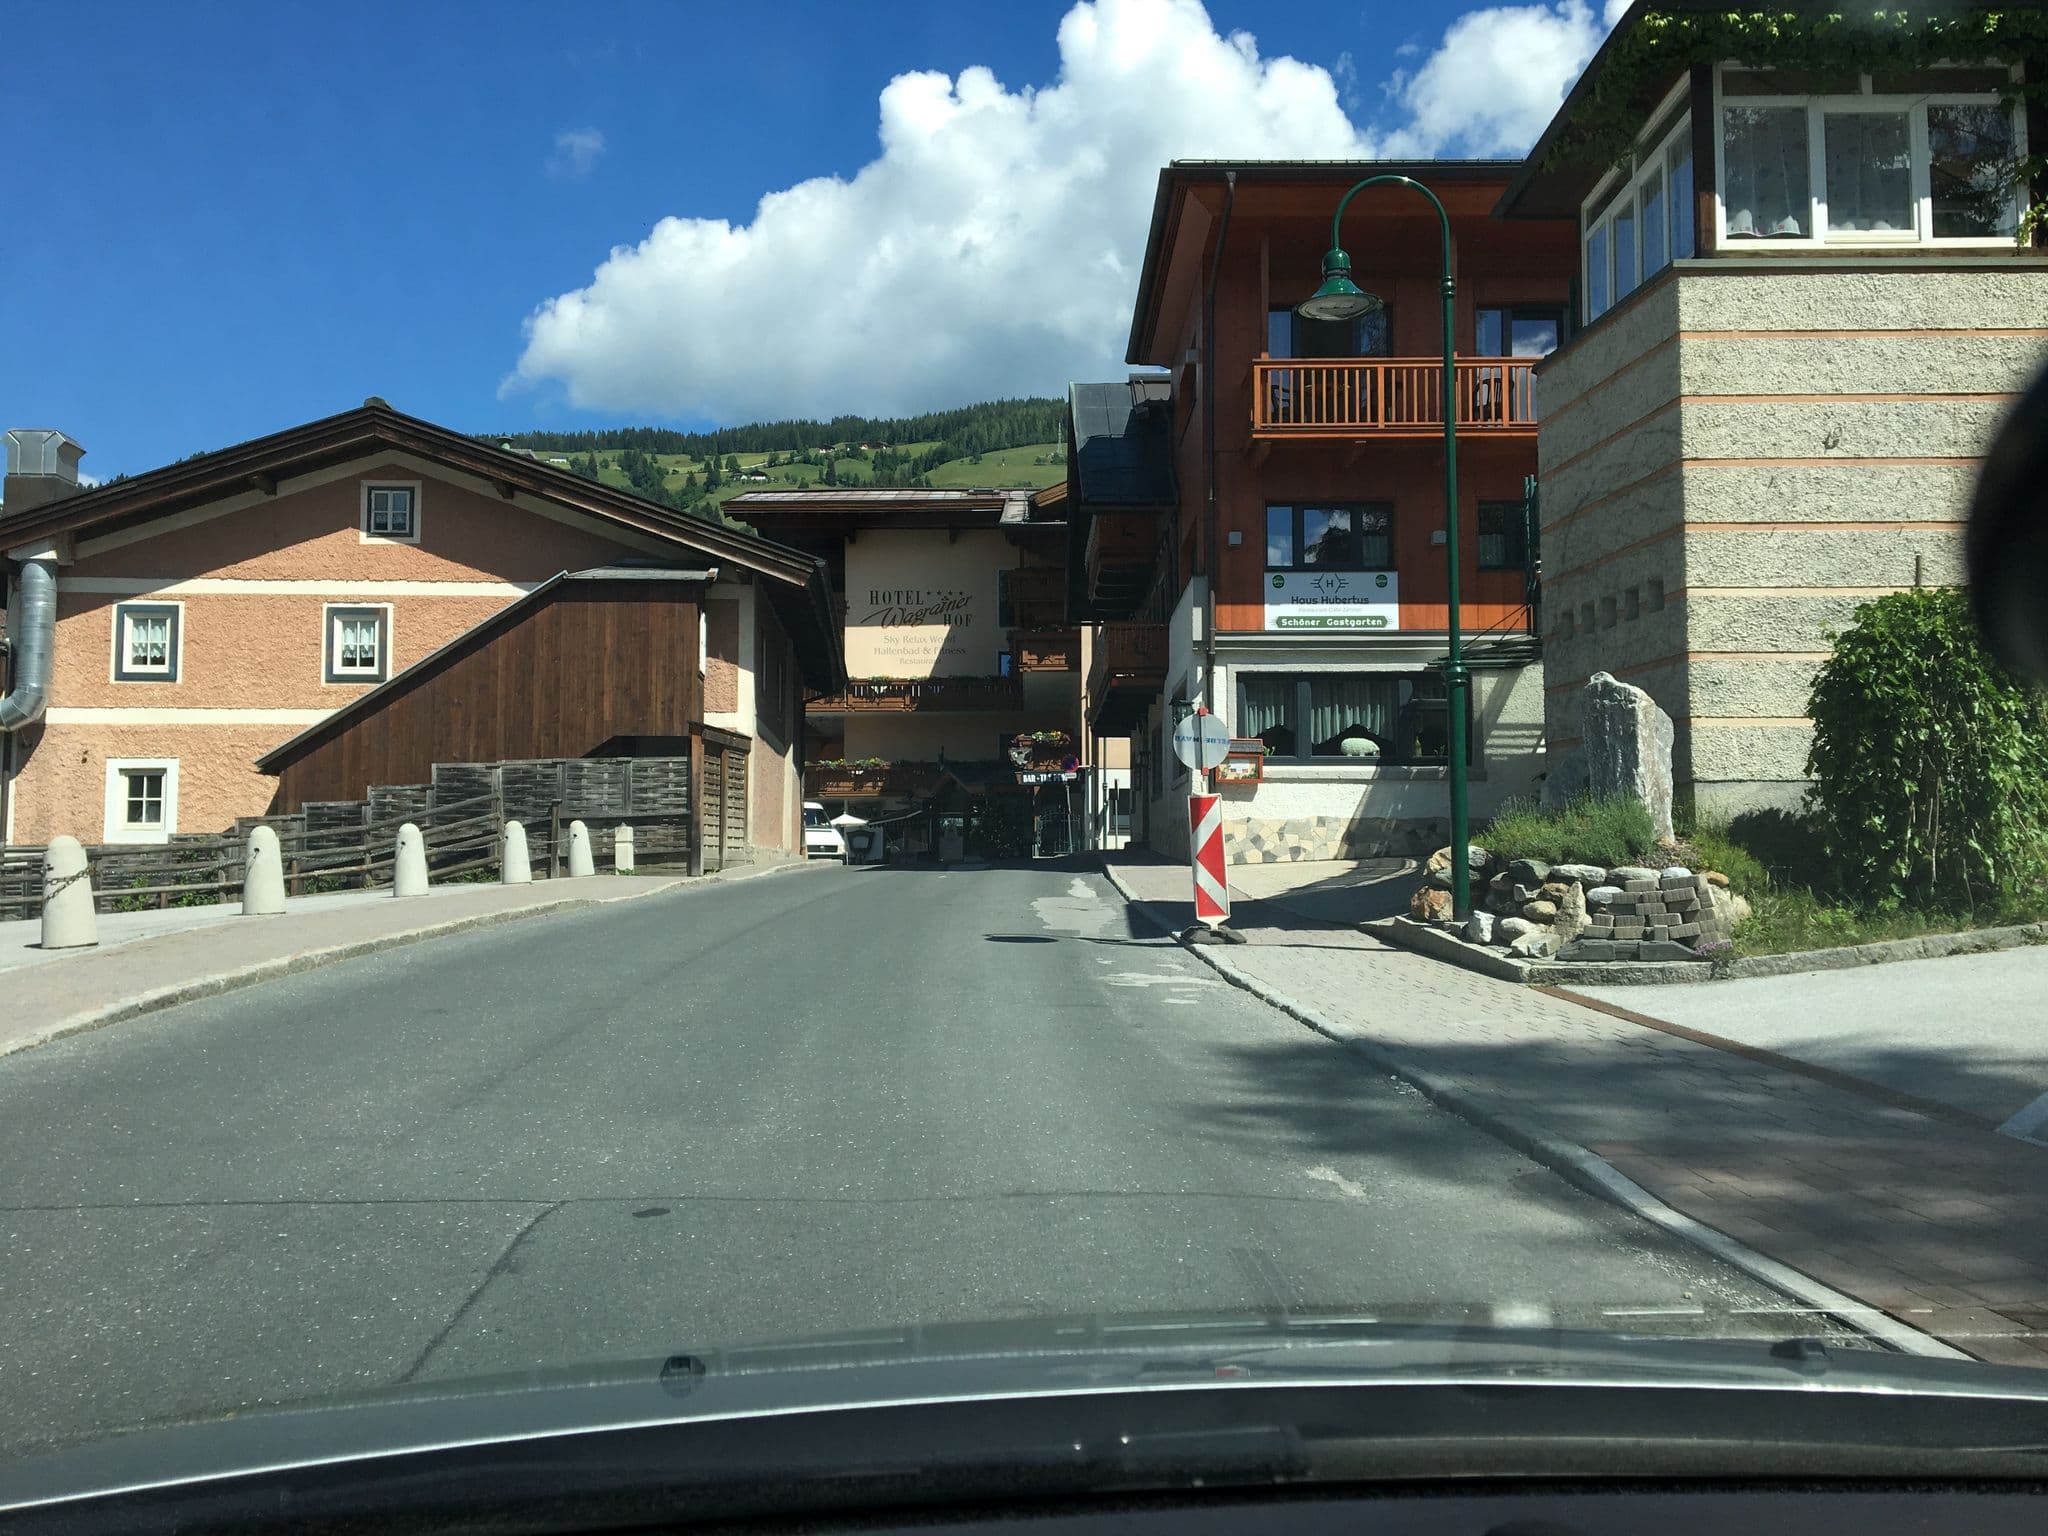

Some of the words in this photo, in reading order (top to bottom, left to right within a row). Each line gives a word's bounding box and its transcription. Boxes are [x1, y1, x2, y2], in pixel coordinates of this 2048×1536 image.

[869, 590, 924, 605] HOTEL
[1291, 596, 1318, 604] Haus
[1321, 596, 1369, 604] Hubertus
[860, 595, 972, 629] Wagrainer
[943, 613, 973, 627] HOF
[1281, 618, 1320, 627] Schöner
[1326, 618, 1382, 628] Gastgarten
[883, 635, 899, 644] Sky
[903, 635, 926, 643] Relax
[874, 647, 919, 655] Hallenbad
[925, 647, 931, 655] &
[1174, 735, 1230, 745] FELBEMAYR
